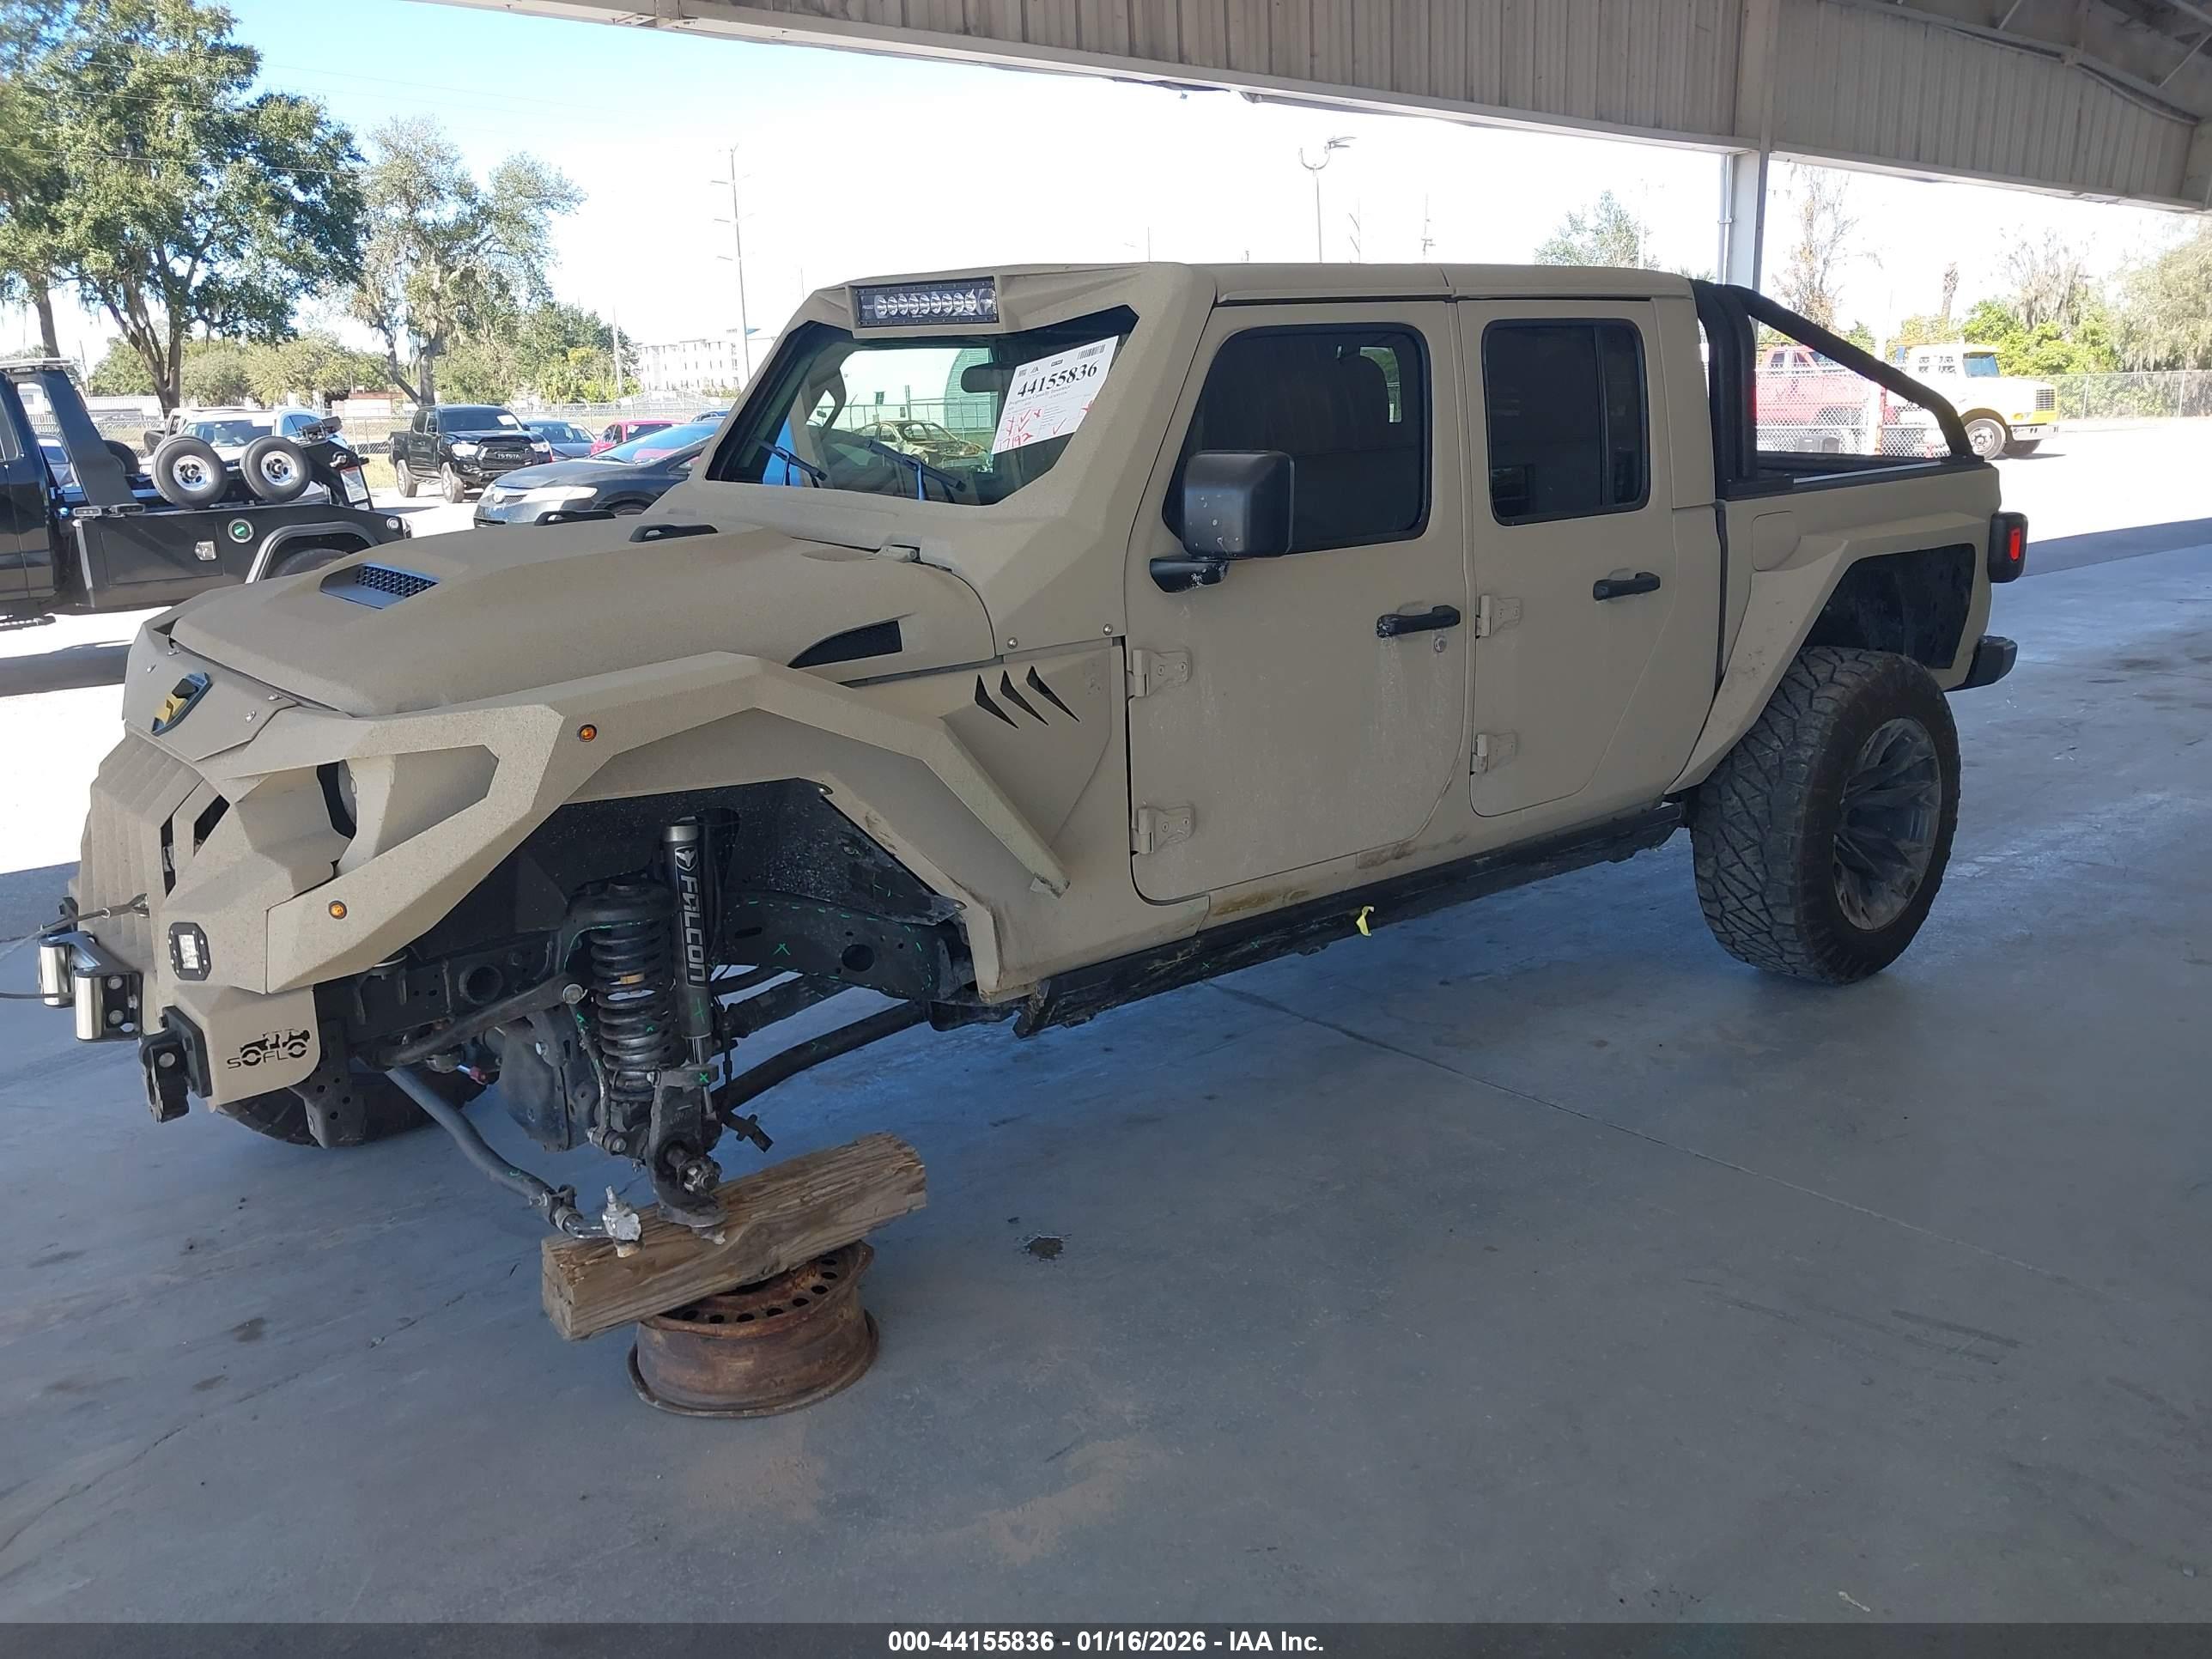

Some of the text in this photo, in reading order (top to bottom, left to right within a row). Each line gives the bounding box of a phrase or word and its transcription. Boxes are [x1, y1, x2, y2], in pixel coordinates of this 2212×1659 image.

[1017, 359, 1100, 398] 44155836
[679, 873, 707, 982] FALCON
[226, 1040, 308, 1070] SOFLO
